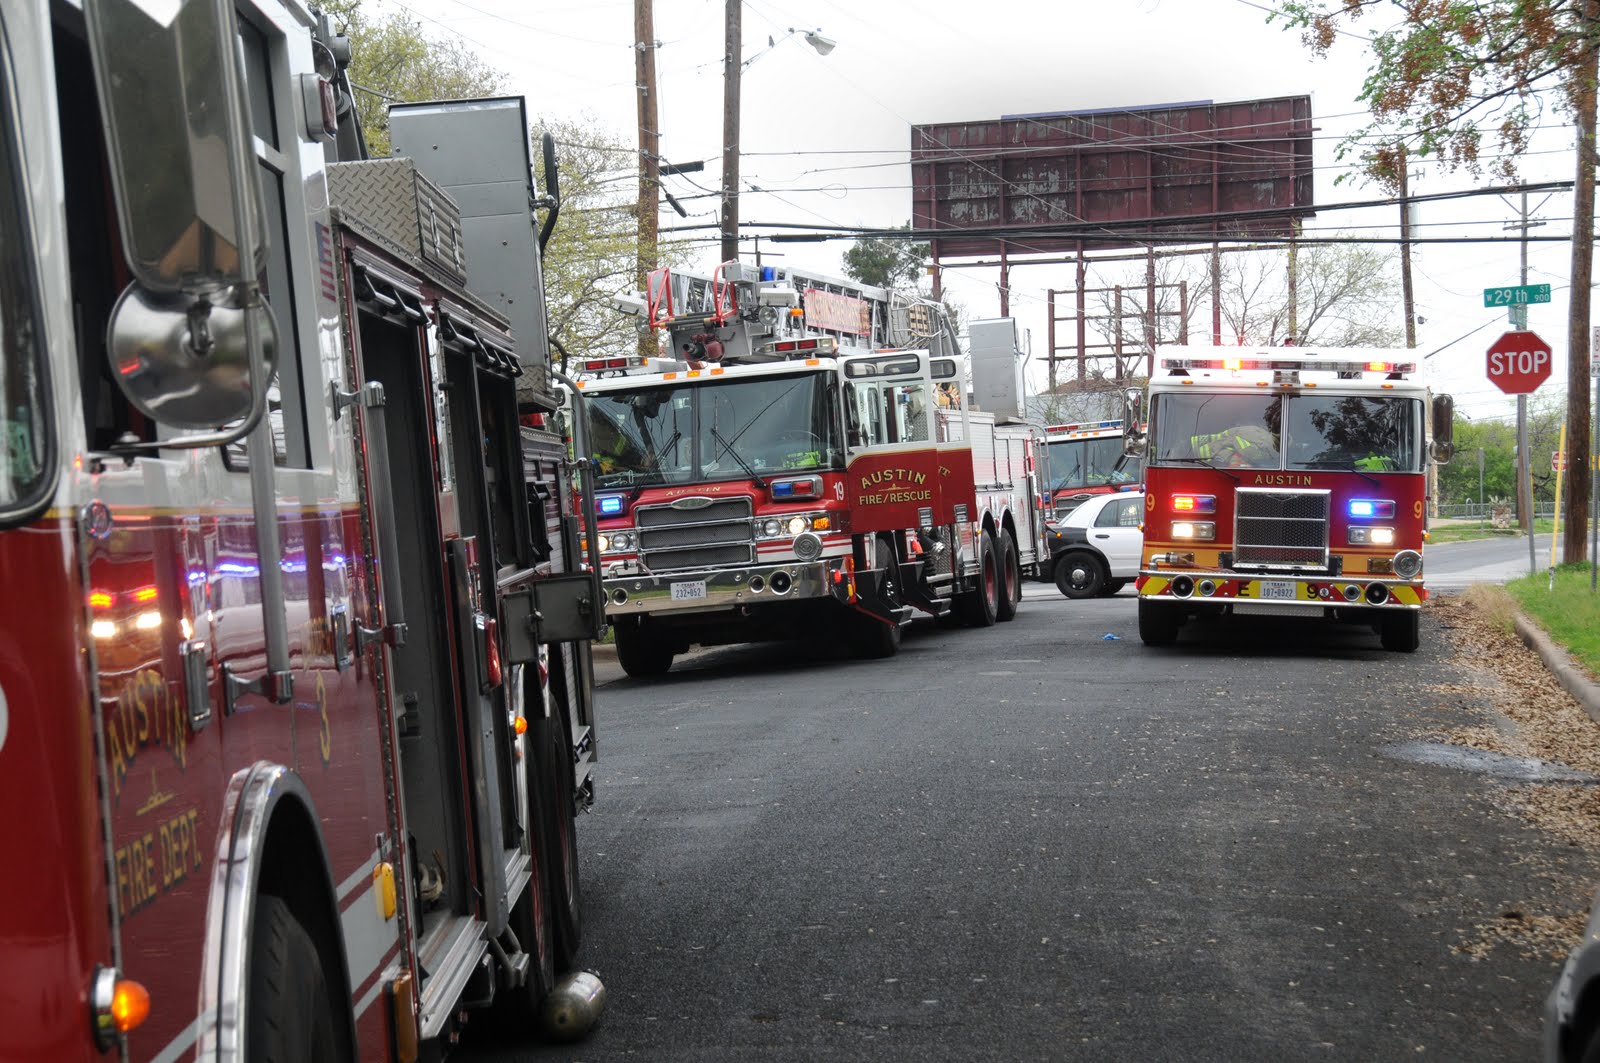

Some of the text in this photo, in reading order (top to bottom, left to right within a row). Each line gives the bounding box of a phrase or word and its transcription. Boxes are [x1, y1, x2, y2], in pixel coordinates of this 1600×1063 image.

[1486, 294, 1492, 302] W
[1539, 285, 1549, 293] ST
[1534, 294, 1550, 302] 900
[1490, 350, 1548, 375] STOP
[861, 468, 926, 489] AUSTIN
[1254, 474, 1312, 486] AUSTIN
[833, 481, 844, 501] 19
[859, 490, 931, 506] FIRE/RESCUE
[1146, 493, 1155, 511] 9
[1413, 500, 1422, 519] 9
[1238, 582, 1319, 599] E 9
[107, 668, 187, 797] AUSTIN
[114, 831, 157, 917] FIRE
